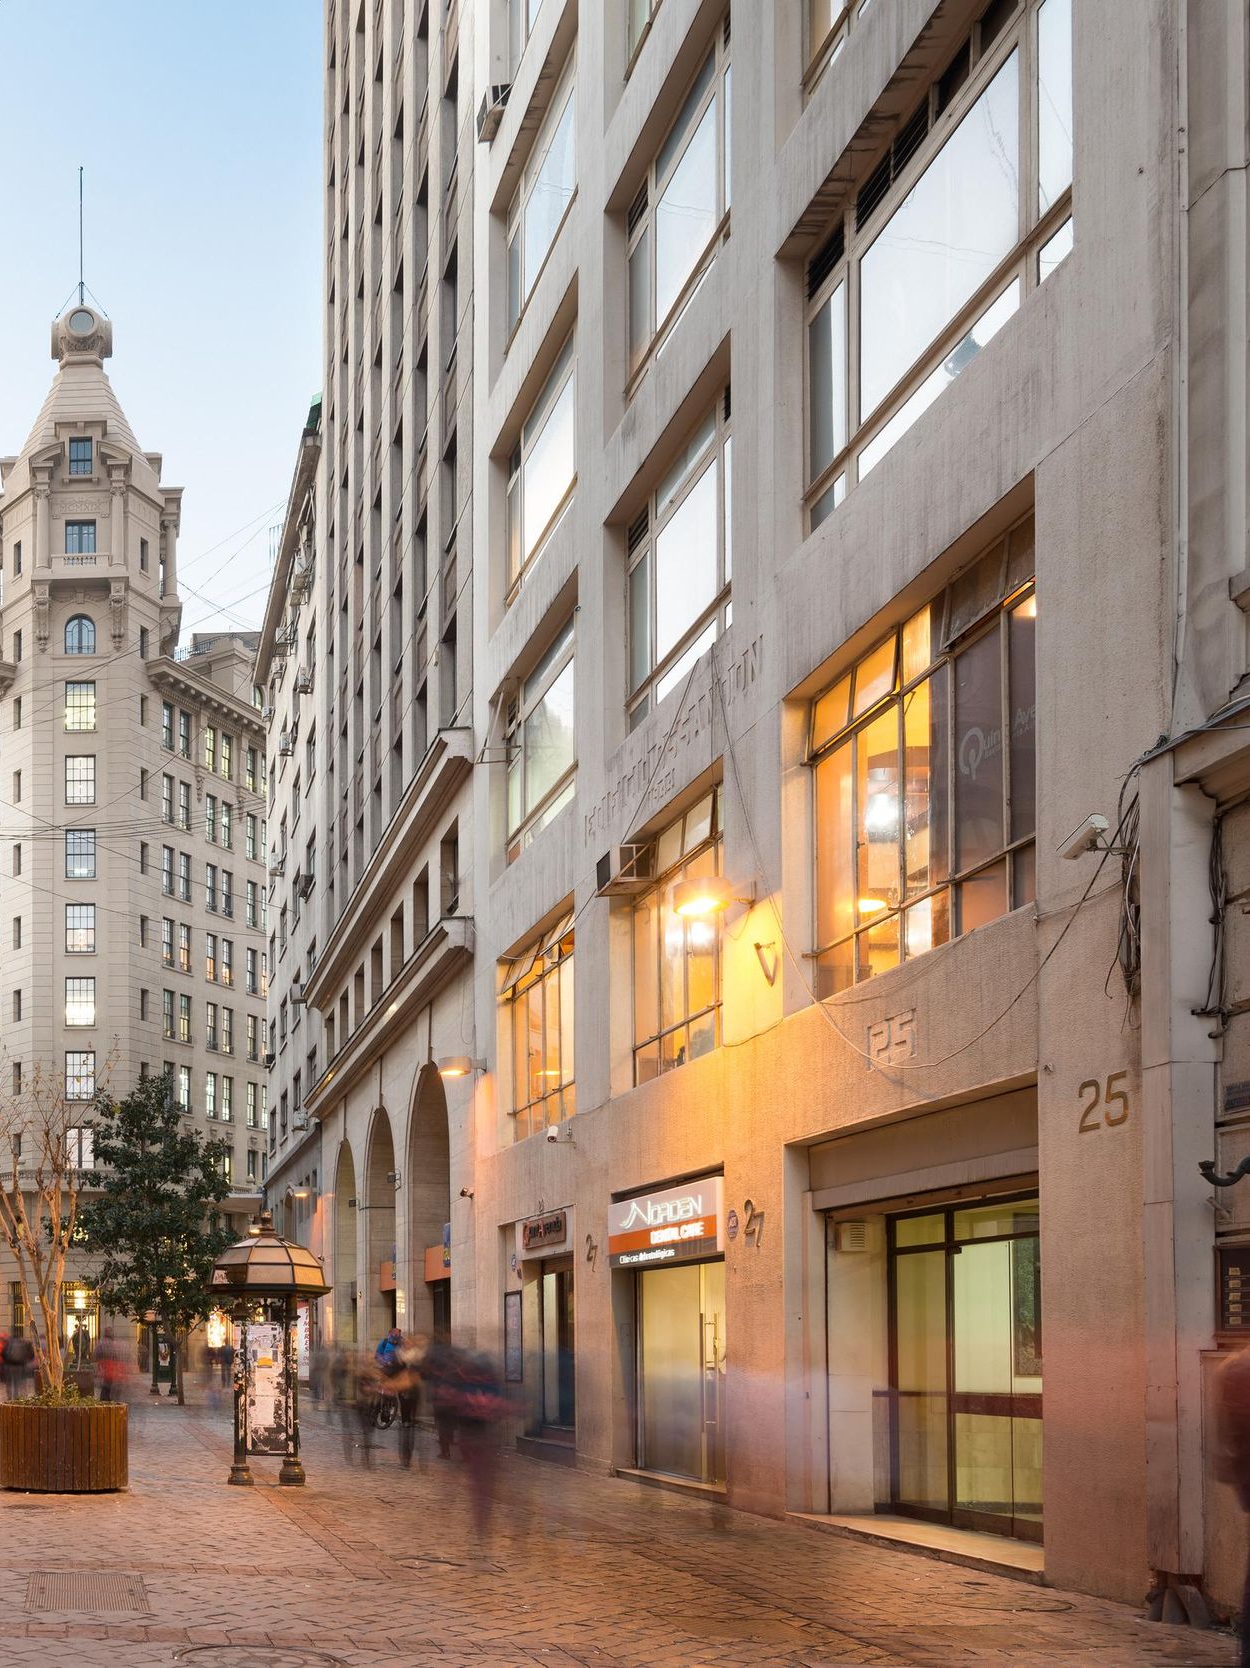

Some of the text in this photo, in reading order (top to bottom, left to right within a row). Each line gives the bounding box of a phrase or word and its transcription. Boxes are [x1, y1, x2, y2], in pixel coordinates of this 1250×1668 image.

[867, 1008, 917, 1072] 25
[1079, 1070, 1128, 1134] 25
[744, 1198, 765, 1247] 27
[586, 1234, 598, 1272] 27
